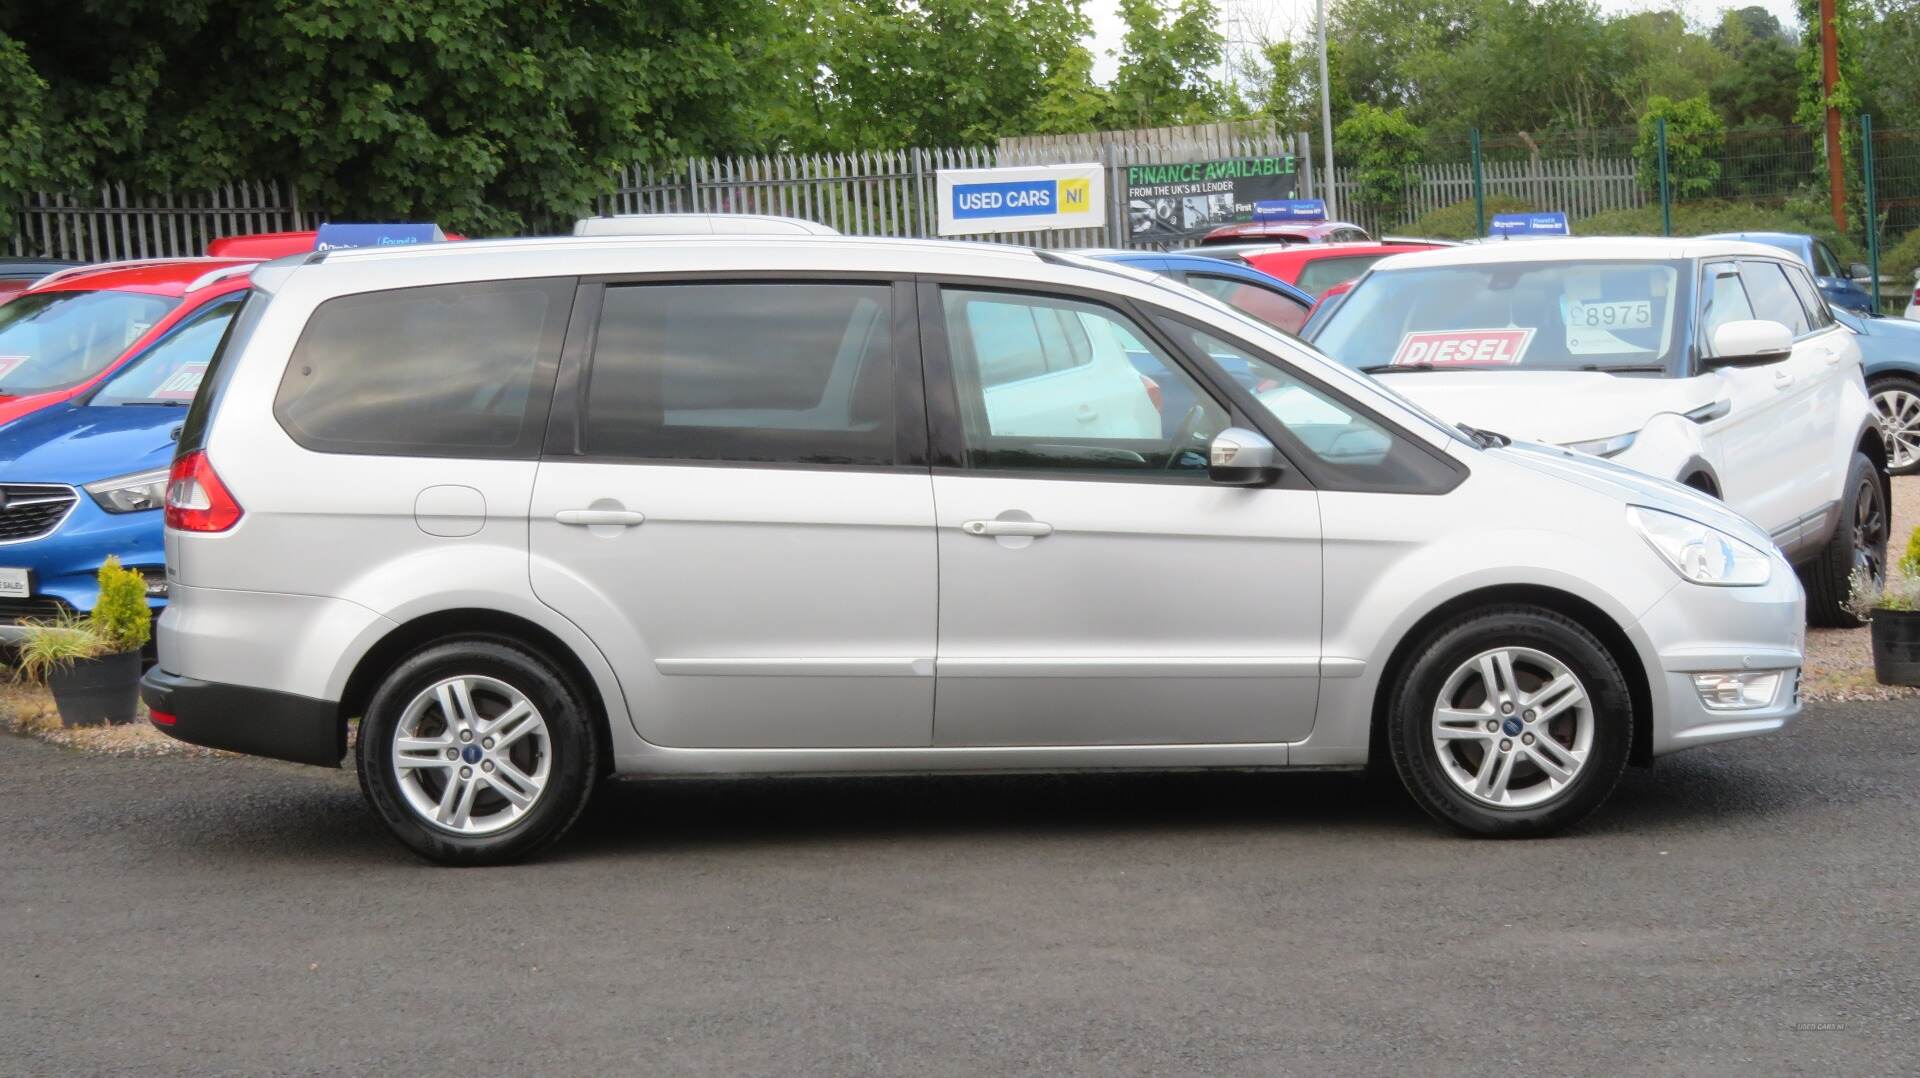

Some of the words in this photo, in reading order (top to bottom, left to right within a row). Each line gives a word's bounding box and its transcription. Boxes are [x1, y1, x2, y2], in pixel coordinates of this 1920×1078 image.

[1129, 164, 1201, 185] FINANCE
[1205, 156, 1295, 181] AVAILABLE
[959, 192, 1002, 210] USED
[1006, 190, 1050, 207] CARS
[1066, 188, 1082, 204] NI
[1129, 187, 1152, 197] FROM
[1154, 186, 1169, 195] THE
[1171, 184, 1190, 194] UK'S
[1191, 183, 1200, 193] #1
[1202, 181, 1234, 192] LENDER
[1402, 339, 1511, 363] DIESEL
